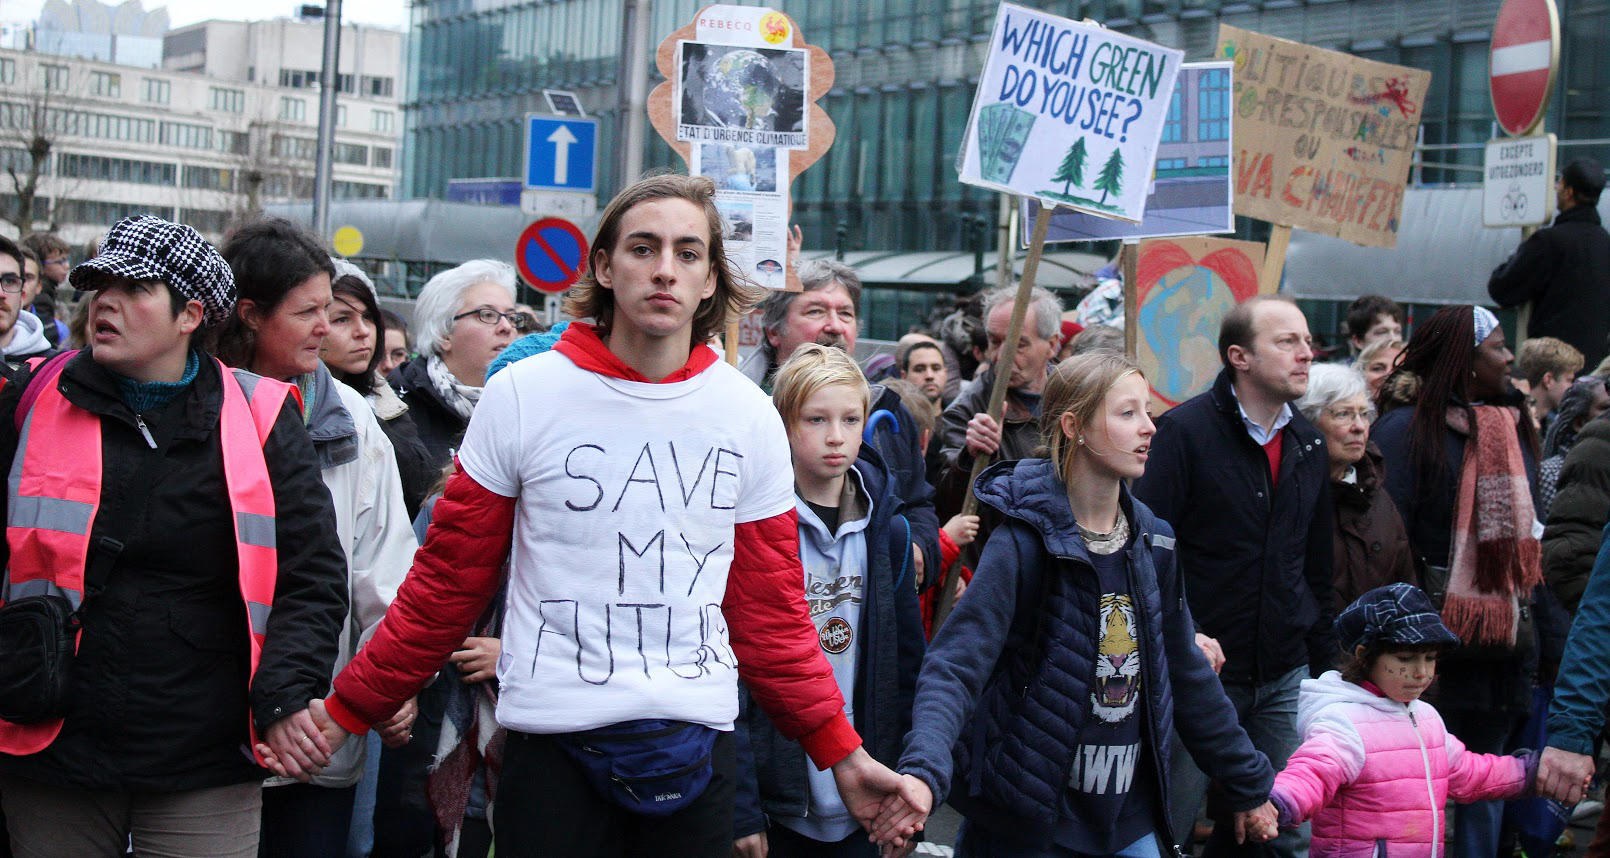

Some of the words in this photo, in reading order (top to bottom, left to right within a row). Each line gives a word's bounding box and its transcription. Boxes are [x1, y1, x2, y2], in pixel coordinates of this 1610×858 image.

[700, 19, 752, 32] REBECQ
[1001, 14, 1089, 80] WHICH
[1089, 42, 1167, 100] GREEN
[703, 128, 754, 143] D'URGENCE
[756, 131, 807, 146] CLIMATIQUE
[999, 64, 1037, 107] DO
[1040, 74, 1085, 125] YOU
[1080, 88, 1143, 143] SEE?
[1236, 149, 1275, 199] VA
[1293, 134, 1321, 160] OU
[564, 440, 744, 513] SAVE
[617, 529, 726, 597] MY
[531, 599, 738, 686] FUTUR
